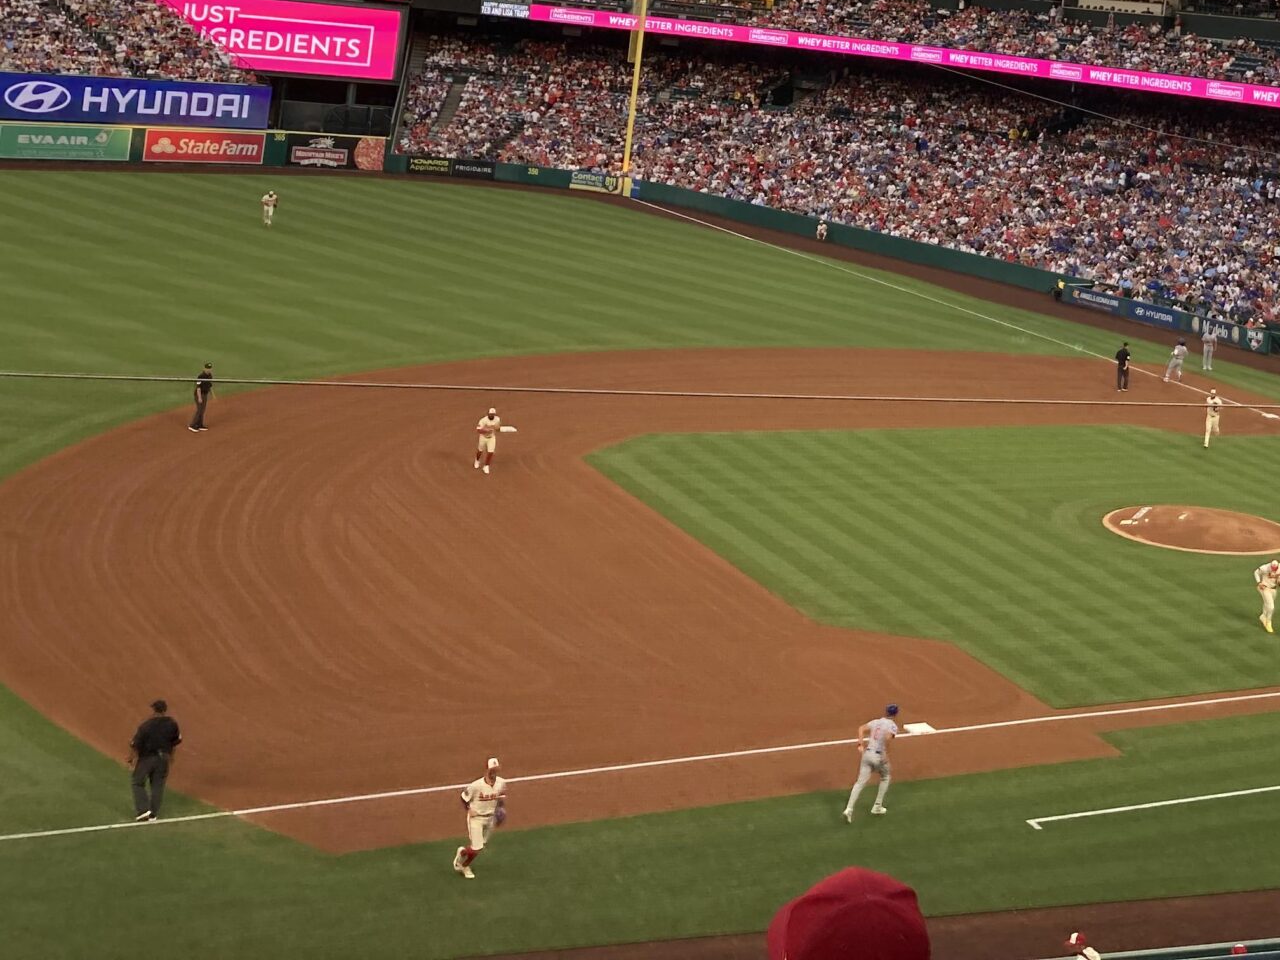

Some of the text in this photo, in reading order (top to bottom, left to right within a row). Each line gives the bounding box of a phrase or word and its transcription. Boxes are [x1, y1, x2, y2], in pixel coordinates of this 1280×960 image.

[183, 3, 240, 24] JUST
[553, 13, 592, 22] INGREDIENTS
[609, 16, 733, 37] WHEY ETTER INGREDIENTS
[200, 25, 361, 58] GREDIENTS
[798, 36, 899, 55] WHEY BETTER INGREDIENTS
[950, 53, 1038, 72] WHEY BETTER INGREDIENTS
[1089, 70, 1191, 91] WHEY BETTER INGREDIENTS
[1208, 88, 1242, 98] INGREDIENTS
[1253, 90, 1278, 102] WHEY
[82, 86, 250, 118] HYUNDAI
[18, 135, 88, 145] EVA AIR
[274, 133, 286, 141] 365
[410, 164, 449, 172] Appliances
[455, 165, 492, 173] FRIGIDAIRE
[572, 172, 602, 182] Contact
[605, 176, 616, 186] 811
[1145, 310, 1173, 323] HYUNDAI
[1202, 319, 1228, 338] Mdelo
